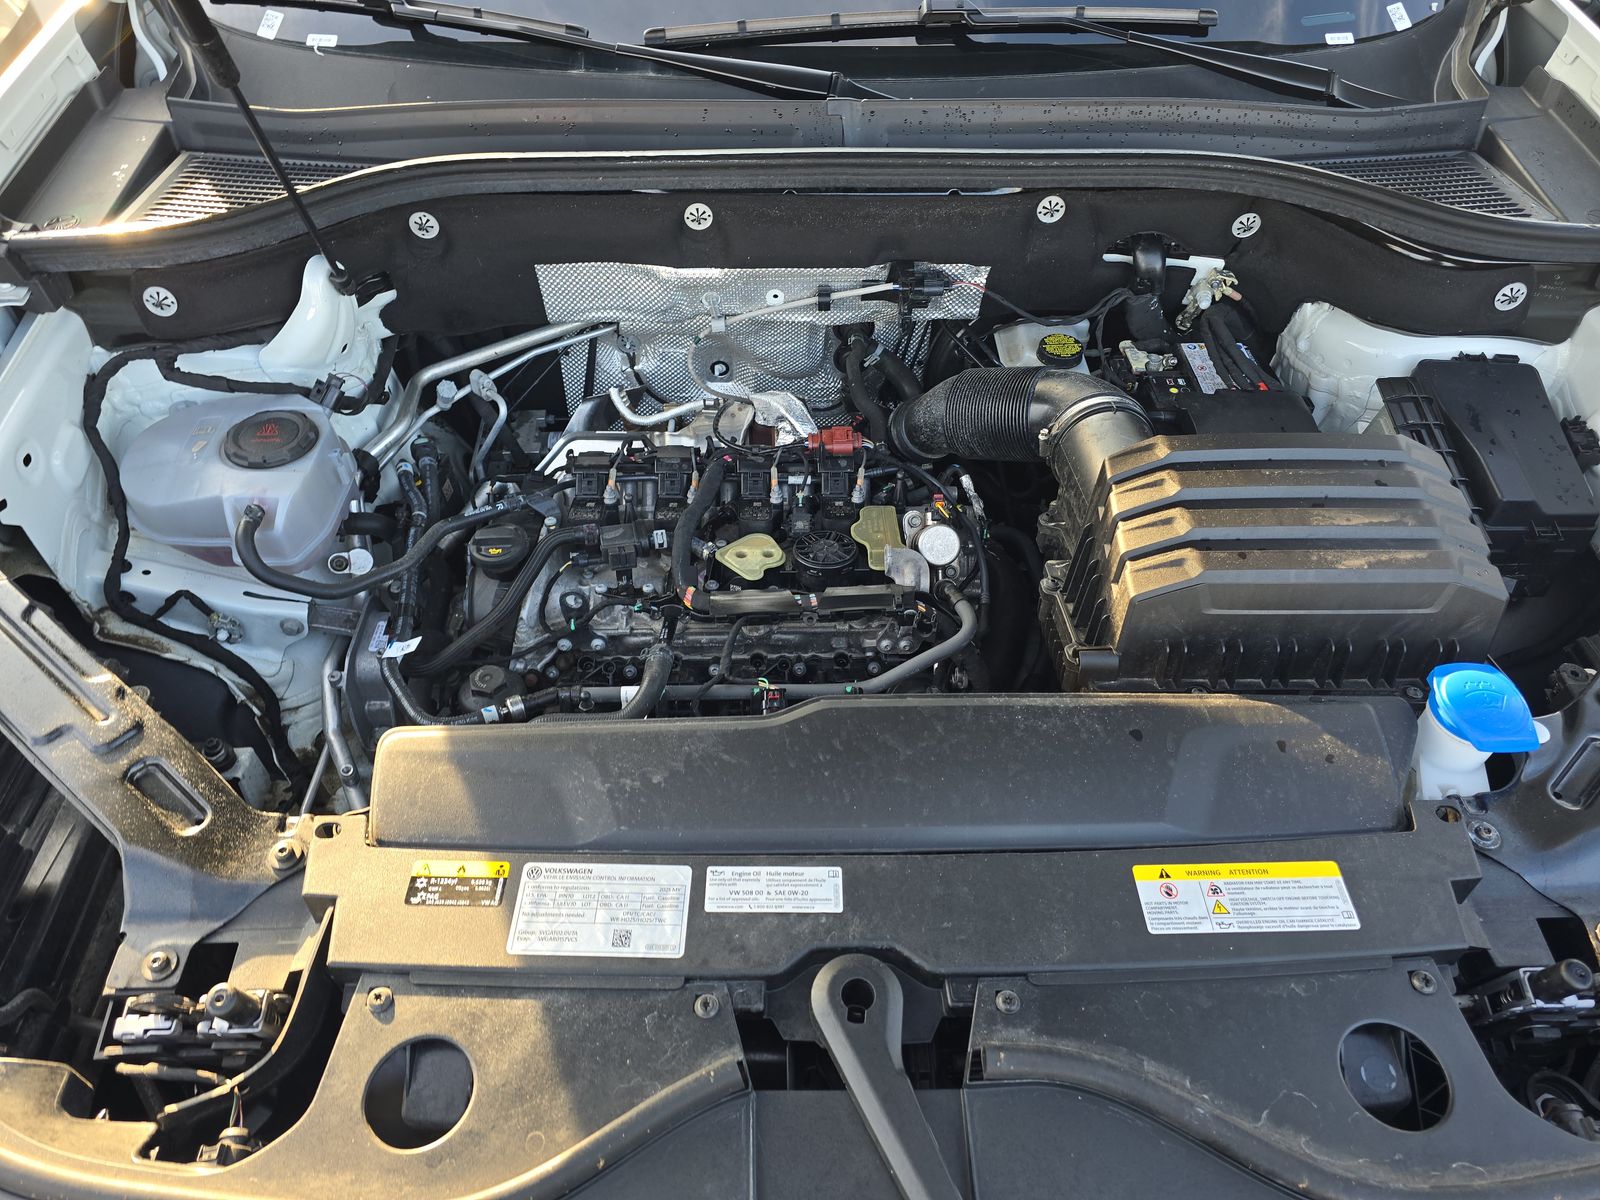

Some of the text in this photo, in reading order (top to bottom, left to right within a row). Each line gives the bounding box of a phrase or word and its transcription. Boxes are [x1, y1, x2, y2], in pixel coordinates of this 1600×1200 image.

[544, 867, 593, 875] VOLKSWAGEN
[1185, 869, 1221, 877] WARNING
[1229, 868, 1269, 876] ATTENTION
